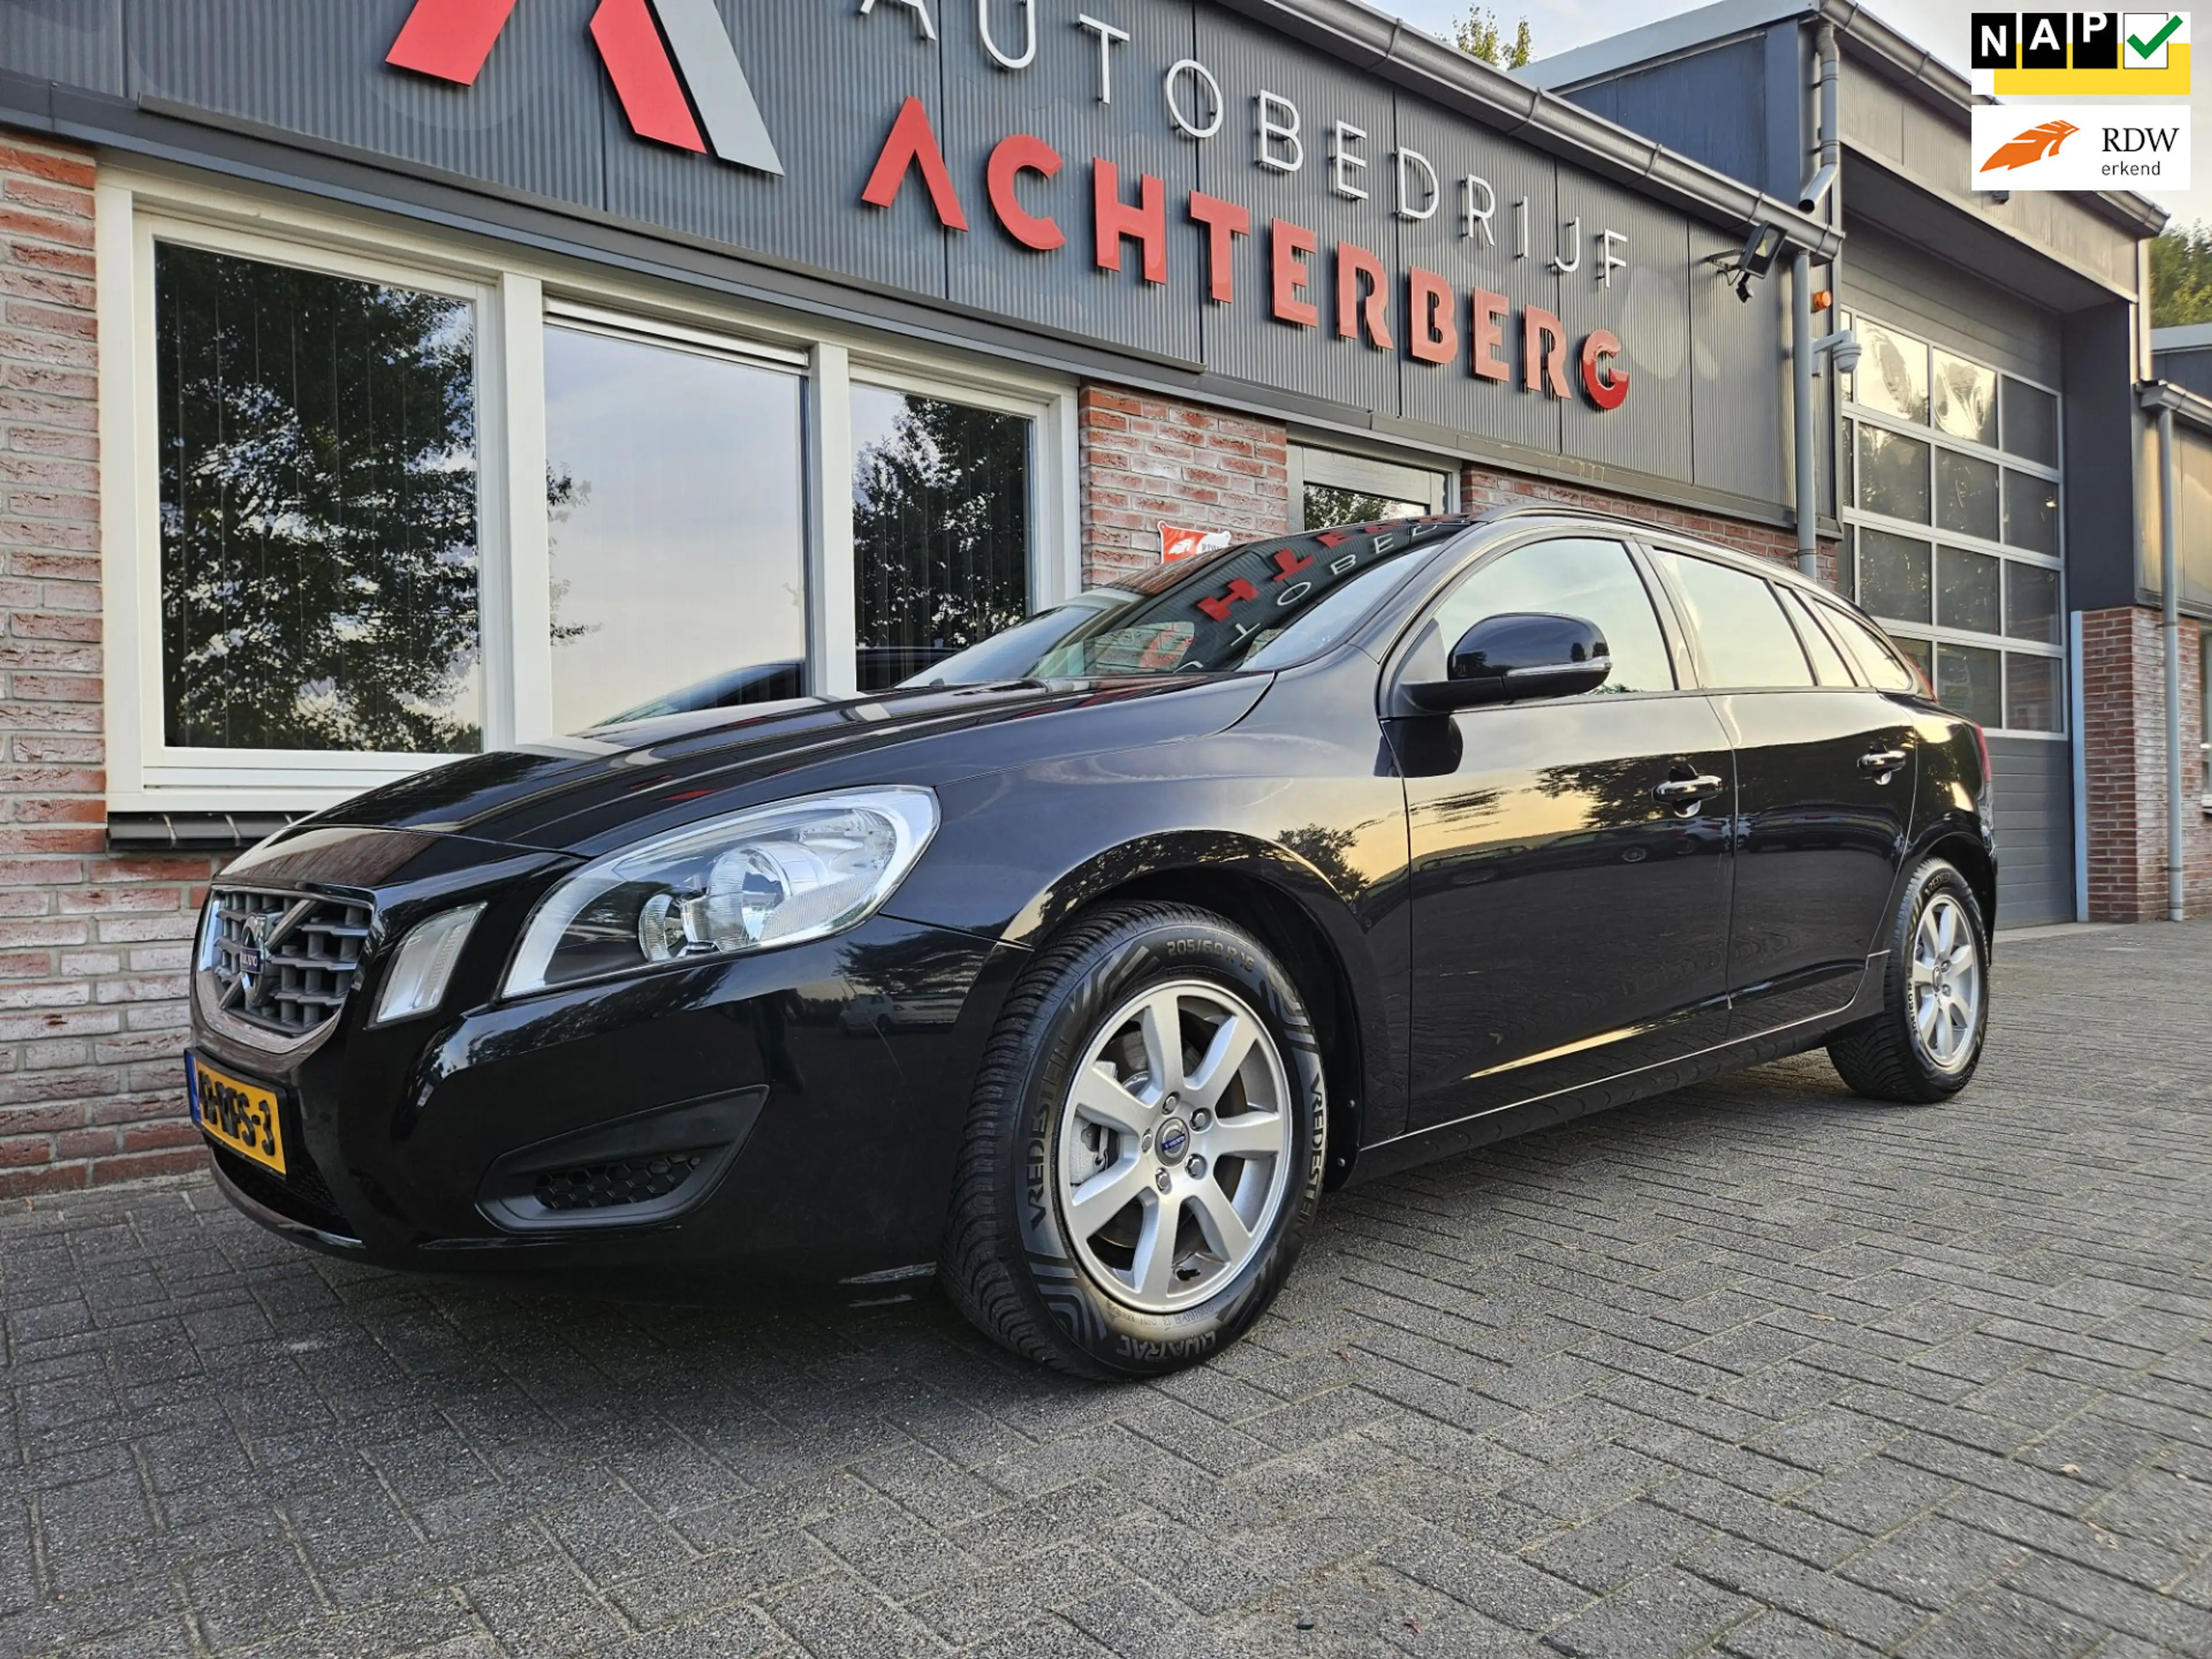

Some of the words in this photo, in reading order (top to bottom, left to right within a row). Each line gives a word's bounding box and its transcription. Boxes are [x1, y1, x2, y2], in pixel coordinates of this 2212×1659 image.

[861, 95, 1630, 410] ACHTERBERG
[1027, 1036, 1071, 1231] VREDESTEIN
[1294, 1071, 1324, 1240] VREDESTEIN
[1116, 1330, 1217, 1363] QUATRAC
